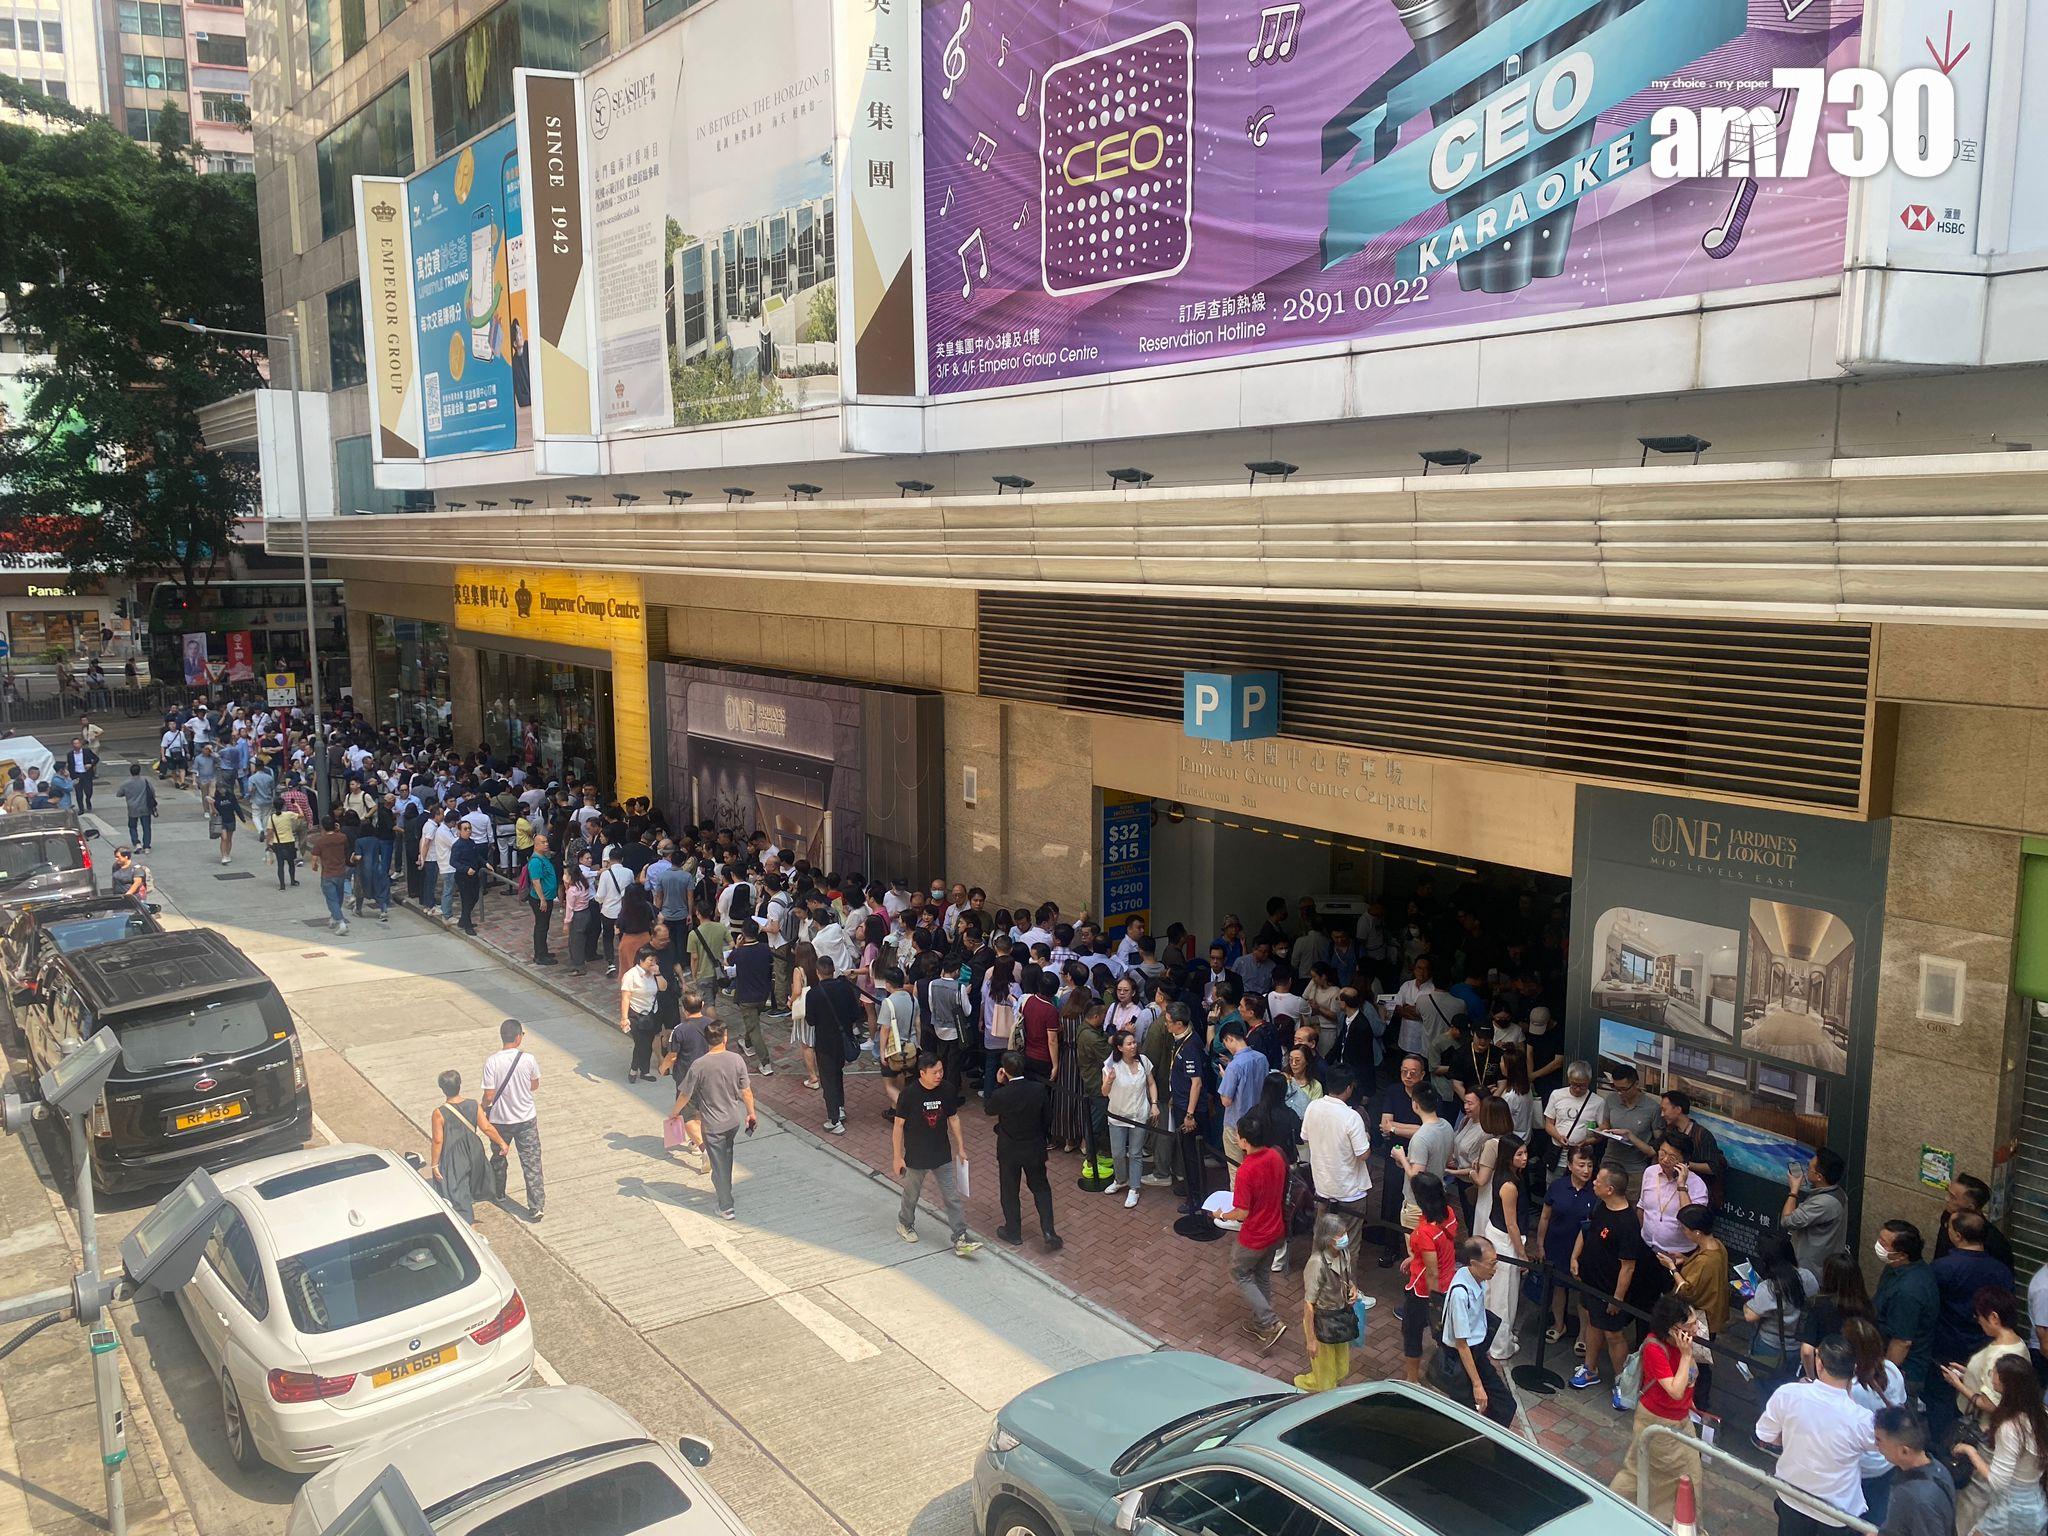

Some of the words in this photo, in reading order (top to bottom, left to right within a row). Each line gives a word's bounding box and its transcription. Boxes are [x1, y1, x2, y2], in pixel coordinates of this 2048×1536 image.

[612, 75, 650, 111] SEASIDE
[696, 122, 706, 141] IN
[753, 95, 771, 117] THE
[774, 72, 820, 107] HORIZON
[1429, 52, 1595, 193] CEO
[545, 116, 565, 187] SINCE
[1062, 125, 1164, 186] CEO
[1417, 131, 1635, 275] KARAOKE
[550, 205, 569, 255] 1942
[1937, 222, 1966, 235] HSBC
[381, 237, 398, 326] EMPEROR
[444, 269, 469, 287] TRADING
[1179, 291, 1267, 323] 訂房查詢熱線
[1283, 287, 1346, 323] 2891
[1354, 276, 1430, 312] 0022
[1139, 326, 1215, 352] Reservation
[1218, 320, 1267, 344] Hotline
[387, 333, 403, 394] GROUP
[936, 363, 950, 378] 3/F
[952, 364, 960, 377] &
[979, 356, 1020, 375] Emperor
[1022, 351, 1057, 368] Group
[1059, 345, 1099, 363] Centre
[540, 592, 576, 615] Emperor
[577, 595, 606, 621] Group
[607, 598, 640, 619] Centre
[725, 695, 756, 734] ONE
[1195, 684, 1219, 726] P
[1242, 685, 1267, 728] P
[1180, 756, 1240, 782] Emperor
[1244, 767, 1291, 793] Group
[1296, 775, 1350, 800] Centre
[1354, 783, 1430, 813] Carpark
[1180, 783, 1230, 804] Headroom
[1109, 823, 1139, 844] $32
[1652, 813, 1721, 861] ONE
[1729, 828, 1797, 853] JARDINE'S
[1109, 842, 1139, 863] $15
[1727, 844, 1796, 869] LOOKOUT
[1650, 855, 1744, 880] MID-LEVELS
[1755, 874, 1795, 888] EAST
[1110, 882, 1143, 897] $4200
[1110, 898, 1143, 913] $3700
[115, 1094, 142, 1103] HYUNDAI
[209, 1108, 230, 1120] 136
[390, 1364, 409, 1380] BA
[413, 1351, 441, 1372] 669
